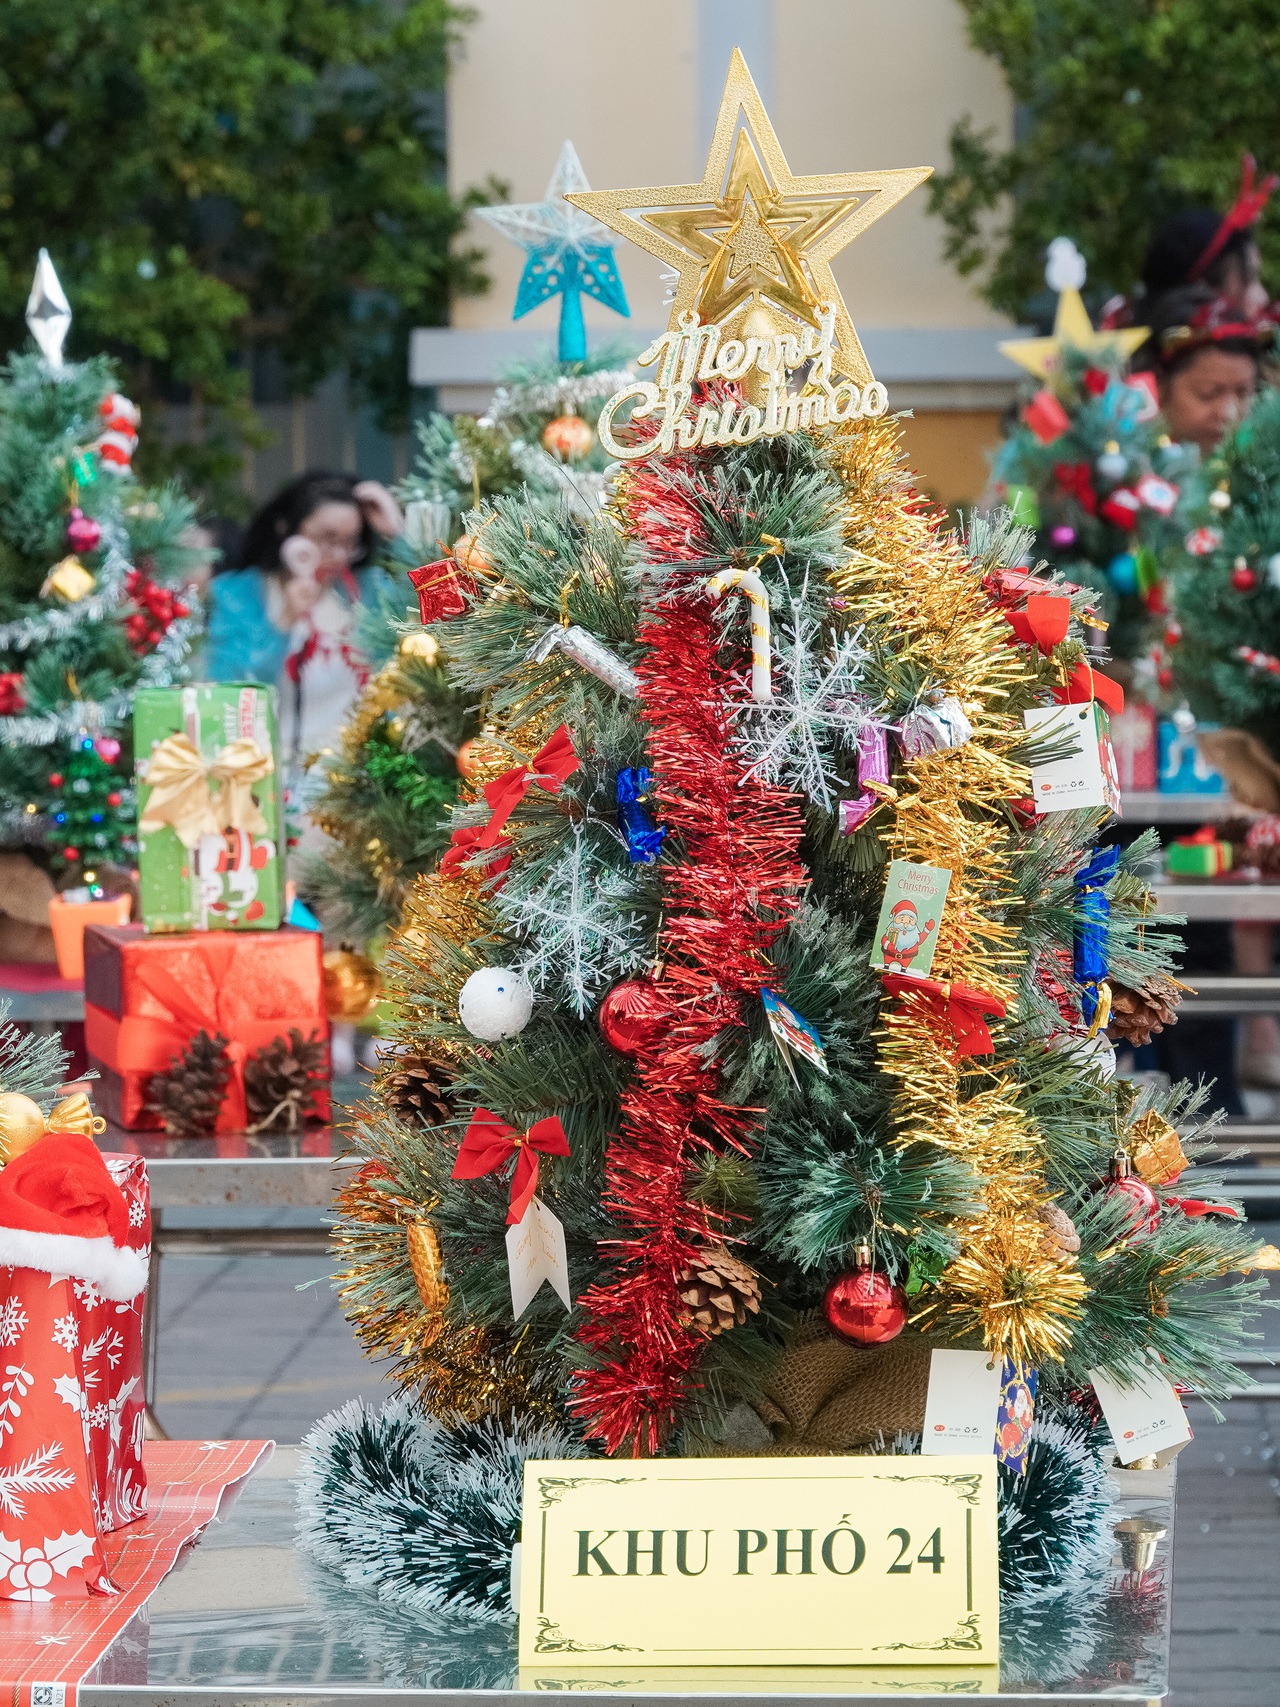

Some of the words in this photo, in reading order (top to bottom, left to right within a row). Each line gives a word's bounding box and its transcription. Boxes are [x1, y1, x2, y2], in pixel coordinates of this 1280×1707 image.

[637, 303, 837, 392] Merry
[597, 372, 890, 460] Christmas
[898, 878, 939, 895] Christmas
[907, 870, 933, 886] Merry
[572, 1529, 715, 1577] KHU
[732, 1513, 867, 1577] PHỐ
[885, 1527, 946, 1575] 24
